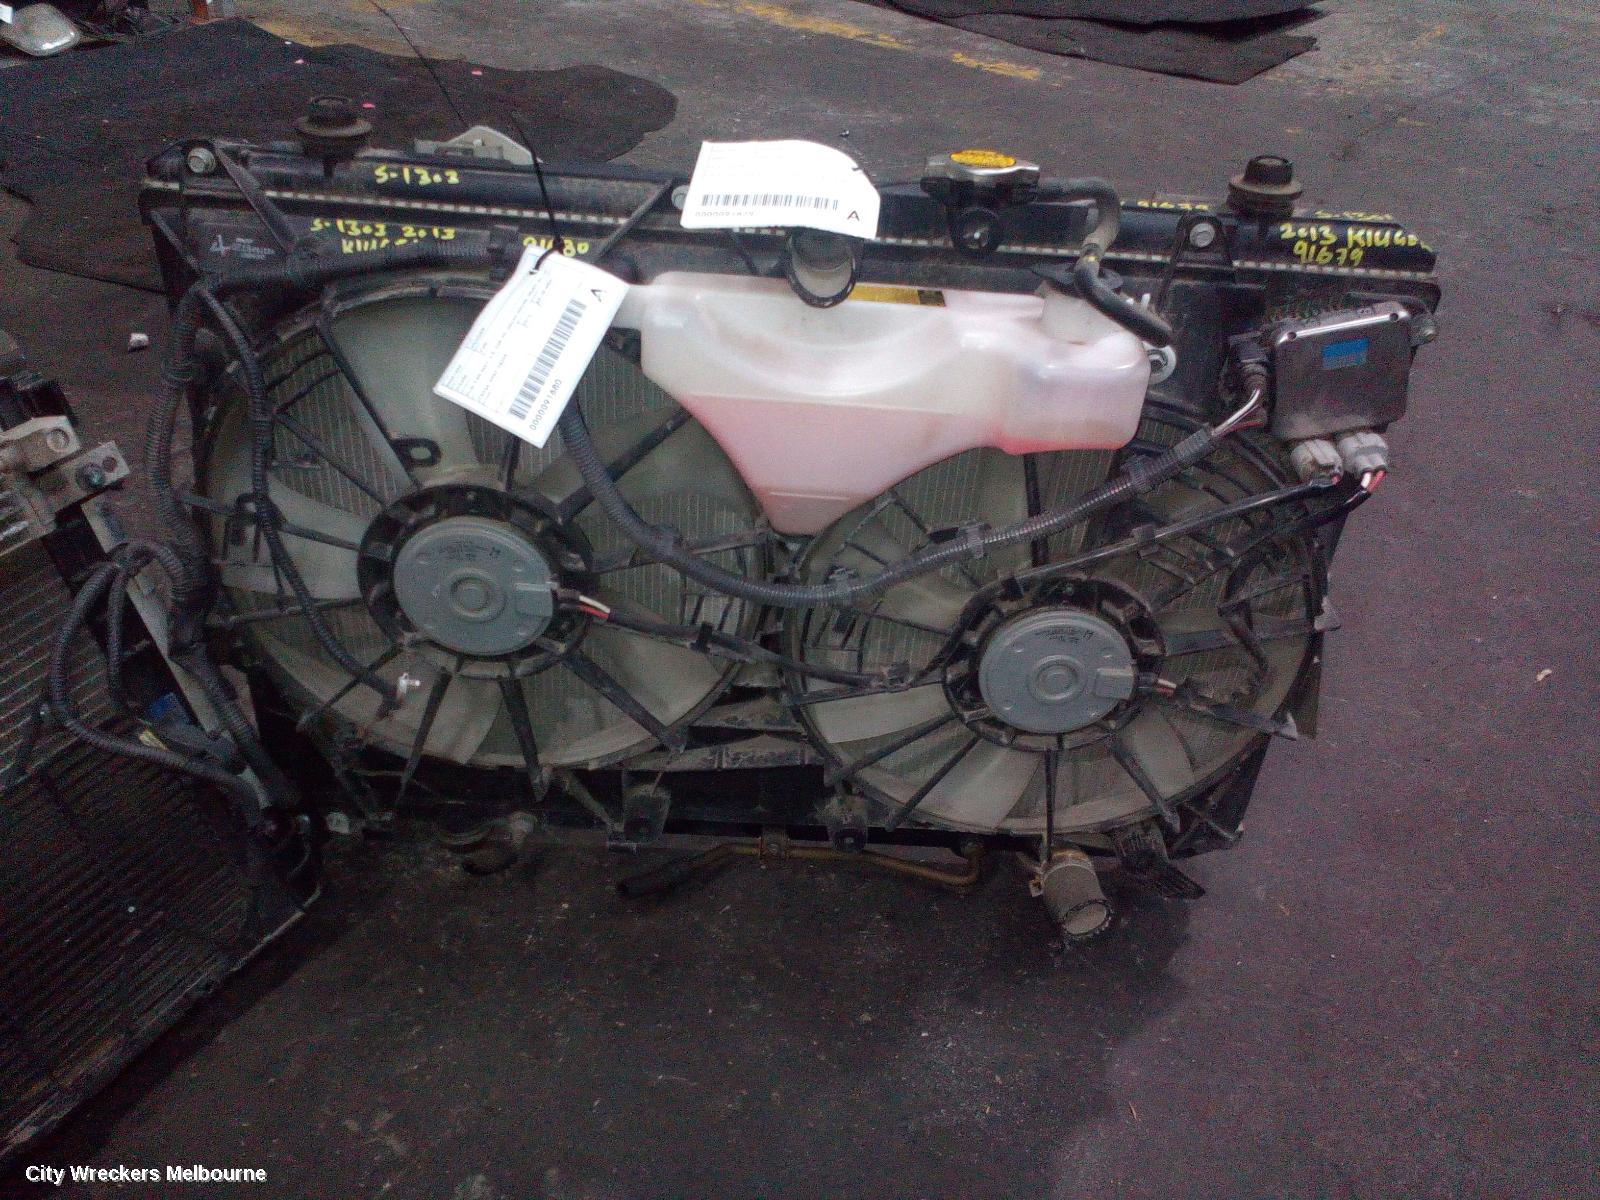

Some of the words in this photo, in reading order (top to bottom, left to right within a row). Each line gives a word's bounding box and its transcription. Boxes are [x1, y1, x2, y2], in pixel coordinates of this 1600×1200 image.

[847, 209, 861, 222] A
[1280, 222, 1338, 246] 2013
[1292, 238, 1365, 267] 91679
[590, 288, 609, 303] A
